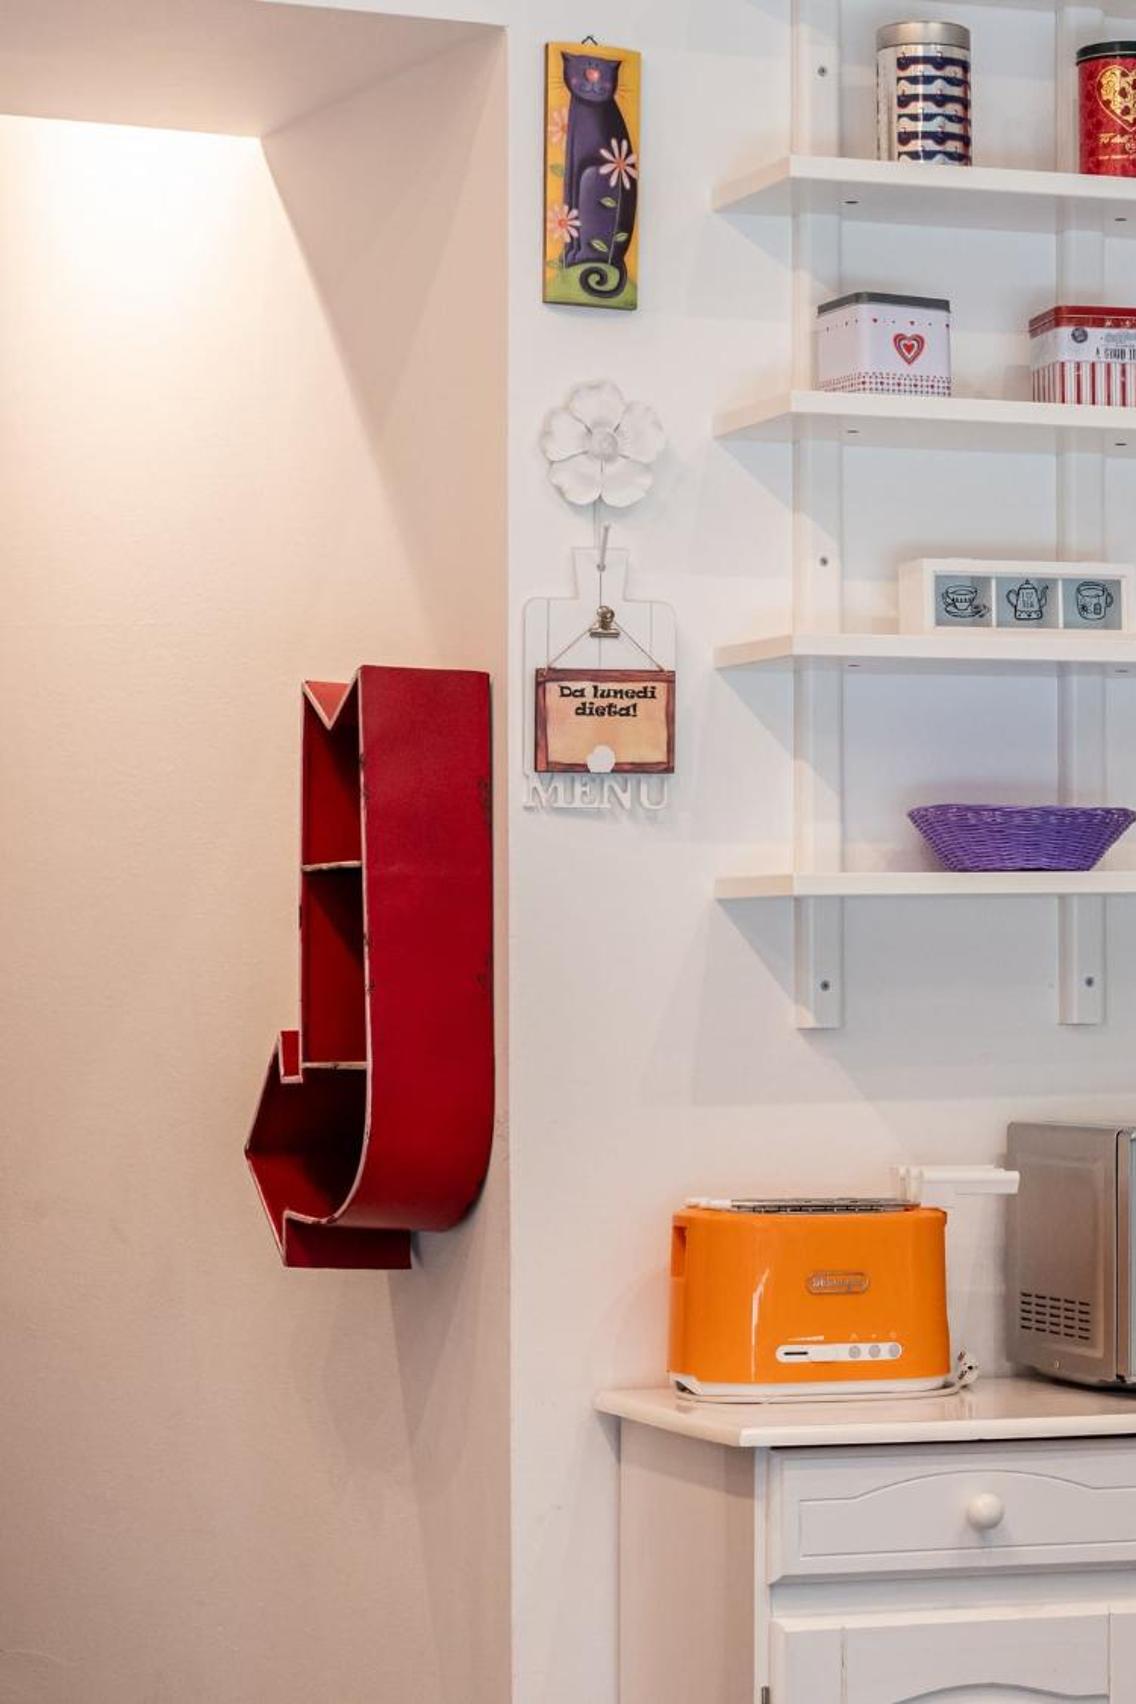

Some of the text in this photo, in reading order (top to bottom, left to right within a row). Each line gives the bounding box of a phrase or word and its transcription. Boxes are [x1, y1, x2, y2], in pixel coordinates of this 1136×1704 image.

[558, 685, 586, 698] Da
[574, 701, 638, 718] dieta!
[523, 772, 669, 810] MENU
